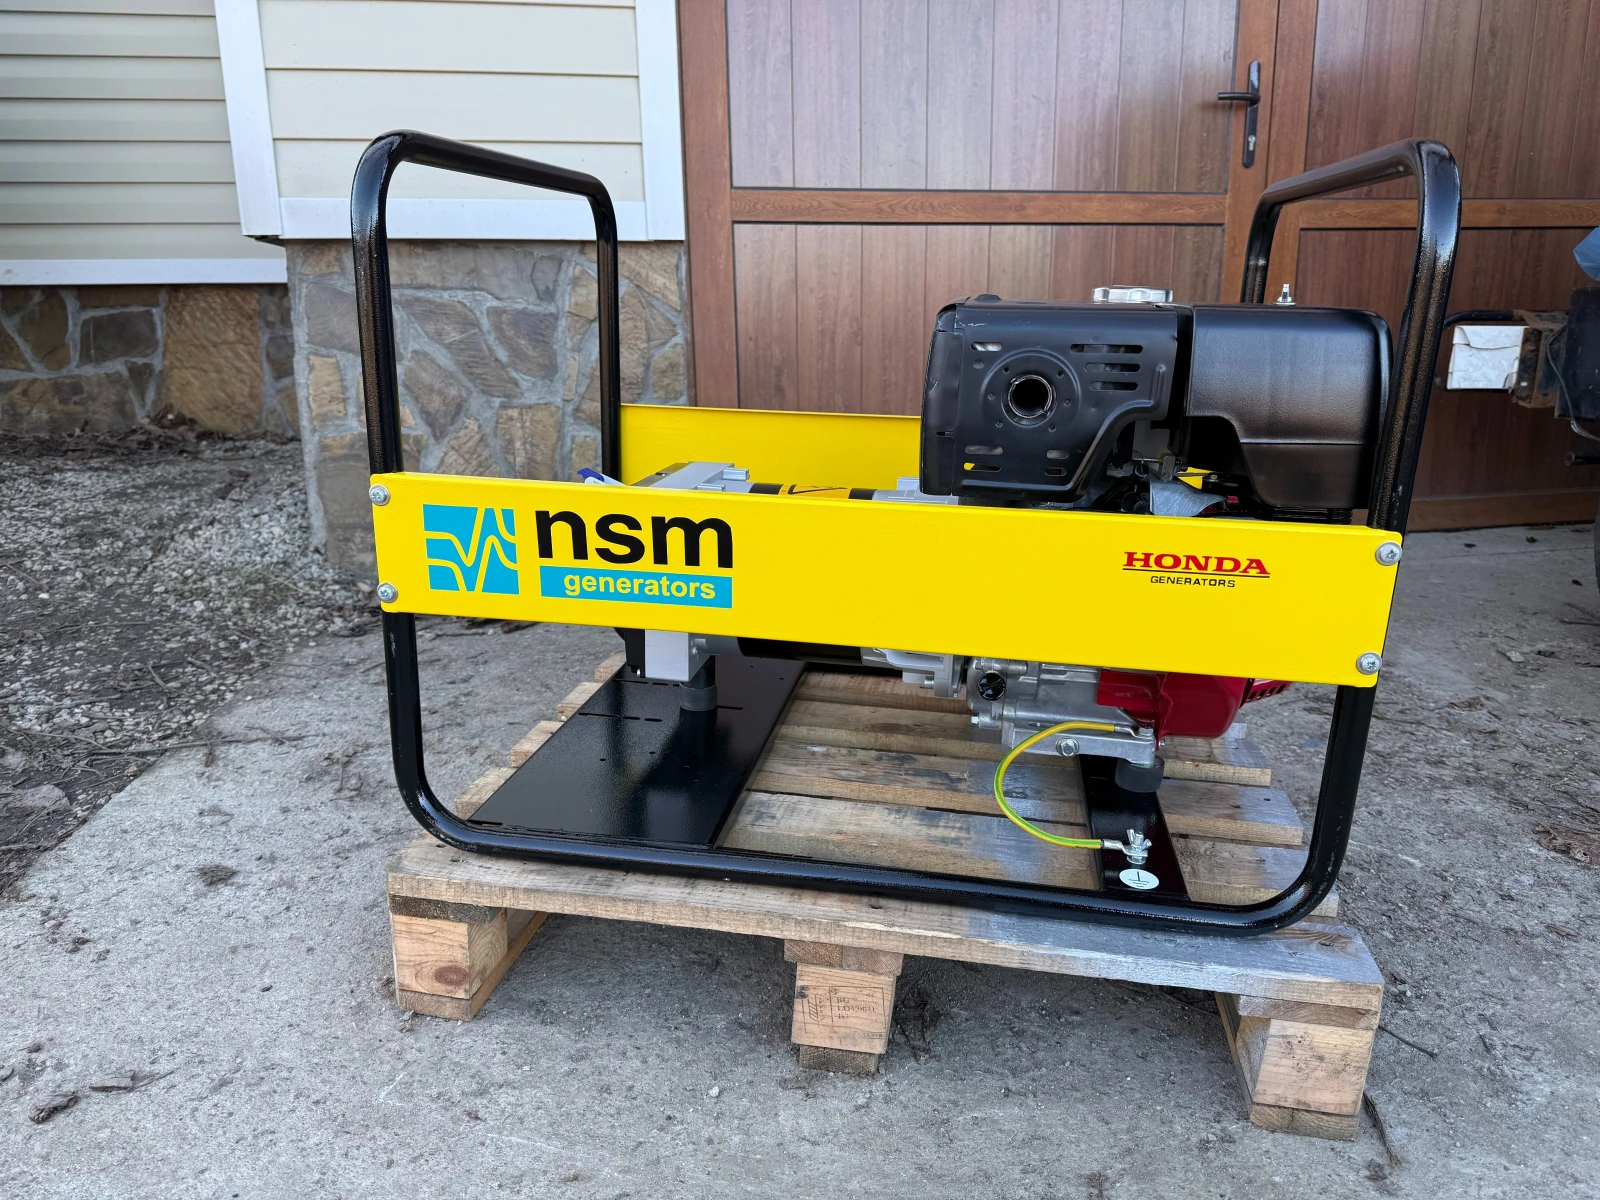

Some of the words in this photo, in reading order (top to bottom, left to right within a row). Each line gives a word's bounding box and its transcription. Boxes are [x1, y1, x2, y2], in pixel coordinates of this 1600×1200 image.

[535, 510, 733, 569] nsm
[1123, 552, 1270, 575] HONDA
[563, 573, 716, 600] generators
[1150, 576, 1236, 588] GENERATORS
